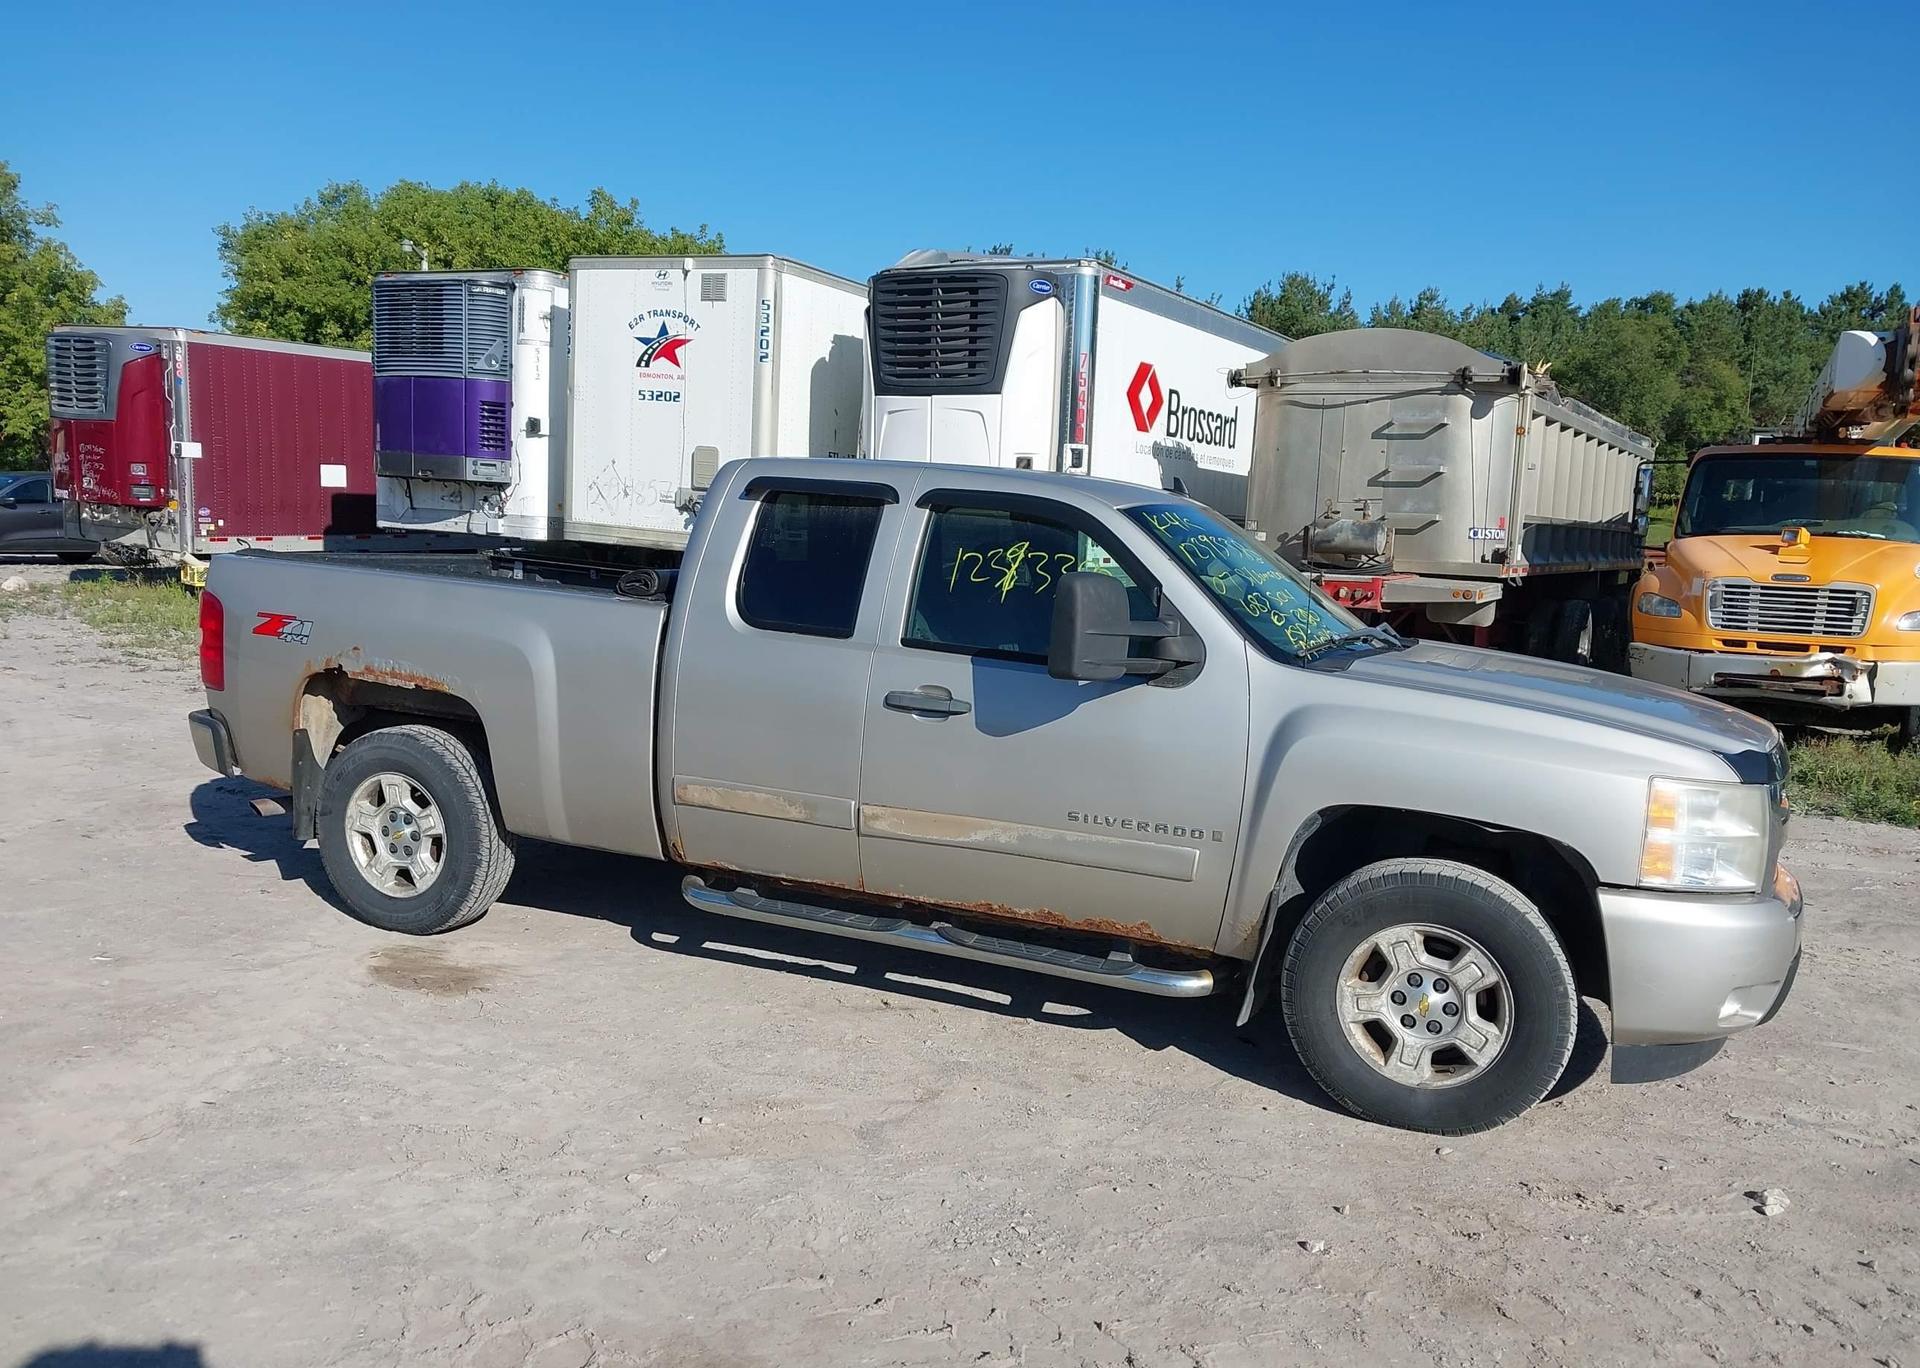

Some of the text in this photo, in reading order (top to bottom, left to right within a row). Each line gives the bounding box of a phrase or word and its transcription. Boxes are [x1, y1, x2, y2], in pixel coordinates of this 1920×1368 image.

[471, 286, 507, 295] CARRIER
[628, 309, 701, 332] E2R TRANSPORT
[760, 299, 771, 363] 53202
[638, 390, 681, 402] 53202
[1166, 388, 1239, 449] Brossard
[1067, 810, 1205, 840] SILVERADO
